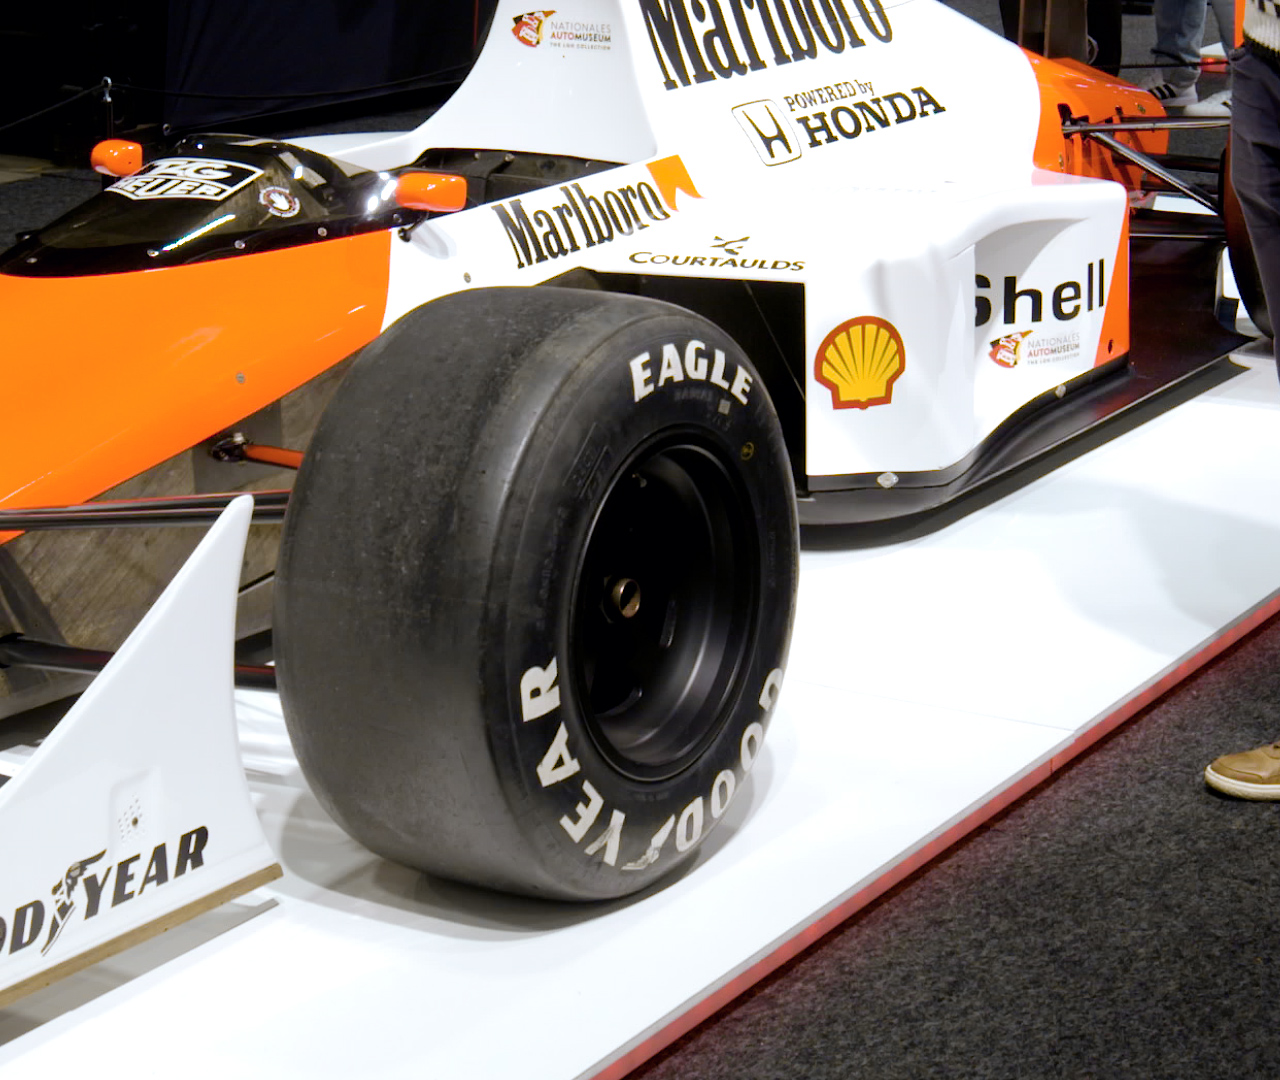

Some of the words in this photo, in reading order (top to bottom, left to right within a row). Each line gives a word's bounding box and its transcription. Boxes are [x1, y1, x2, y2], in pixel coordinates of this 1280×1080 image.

[550, 21, 611, 34] NATIONALES
[550, 31, 612, 43] AUTOMUSEUM
[782, 81, 858, 112] POWERED
[858, 78, 875, 98] by
[796, 85, 946, 149] HONDA
[491, 180, 672, 270] Marlboro
[628, 251, 806, 272] COURTAULDS
[974, 257, 1106, 328] Shell
[1027, 332, 1080, 348] NATIONALES
[1027, 343, 1080, 358] AUTOMUSEUM
[629, 339, 754, 405] EAGLE
